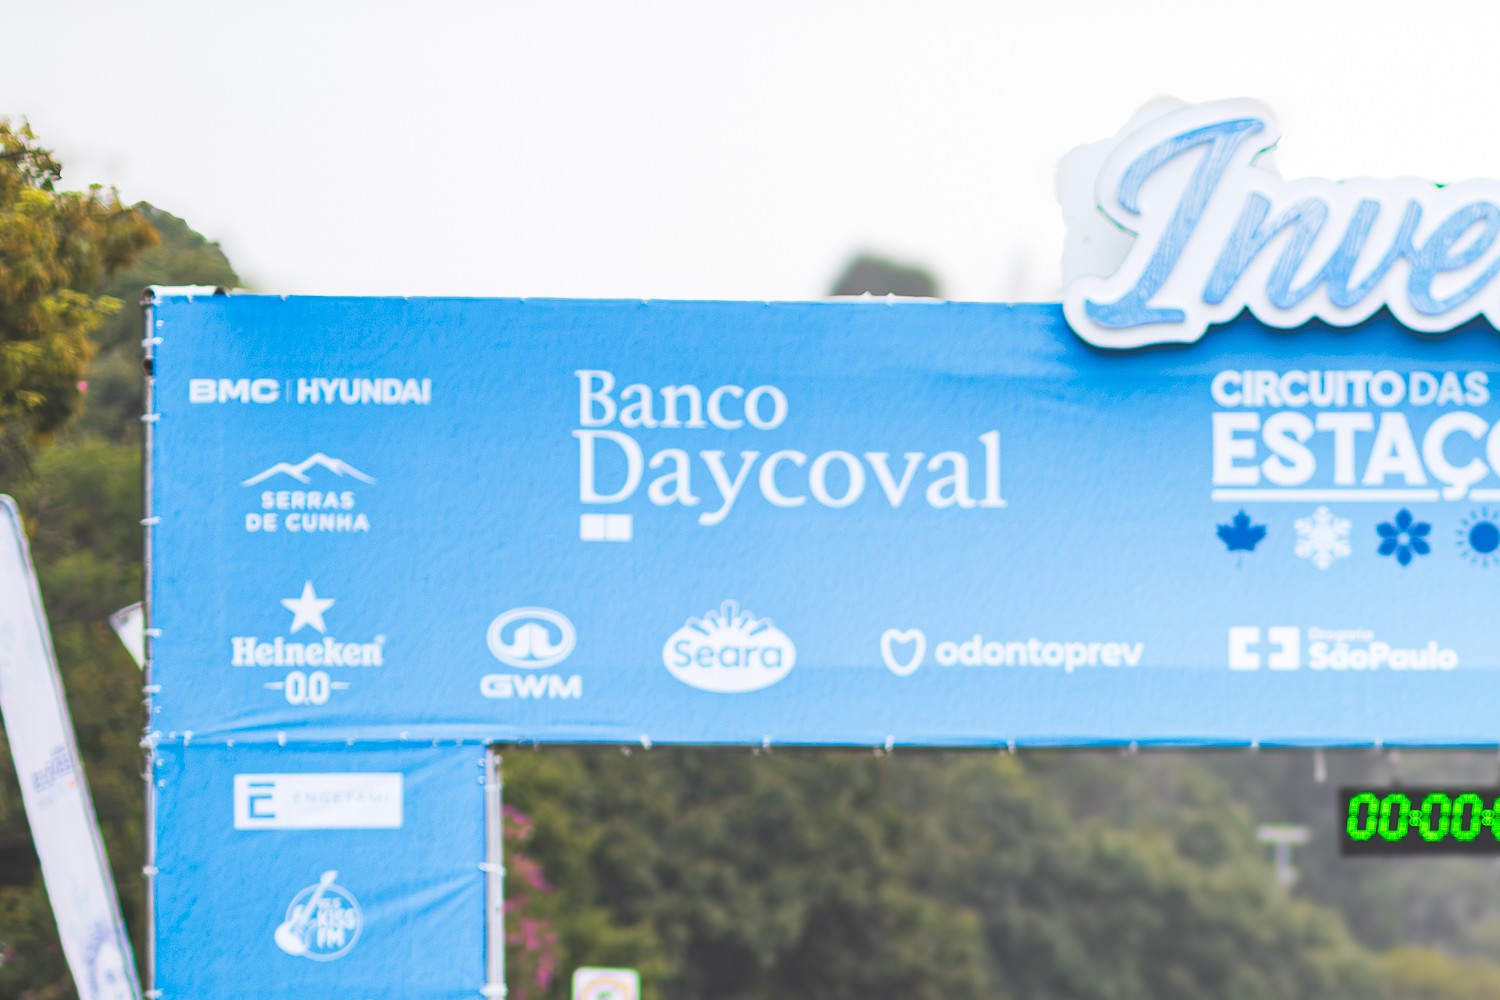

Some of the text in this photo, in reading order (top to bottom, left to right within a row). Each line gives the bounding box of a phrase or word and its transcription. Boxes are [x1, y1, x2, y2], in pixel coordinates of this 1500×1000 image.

[188, 378, 432, 404] BMC HYUNDAI
[574, 369, 789, 430] Banco
[1211, 371, 1490, 408] CIRCUITO DAS
[572, 429, 1009, 526] Daycoval
[261, 490, 356, 511] SERRAS
[245, 513, 370, 533] DE CUNHA
[231, 636, 383, 667] Heineken
[673, 638, 783, 669] Seara
[935, 634, 1144, 674] odontoprev
[480, 674, 582, 699] GWM
[317, 908, 356, 930] KISS
